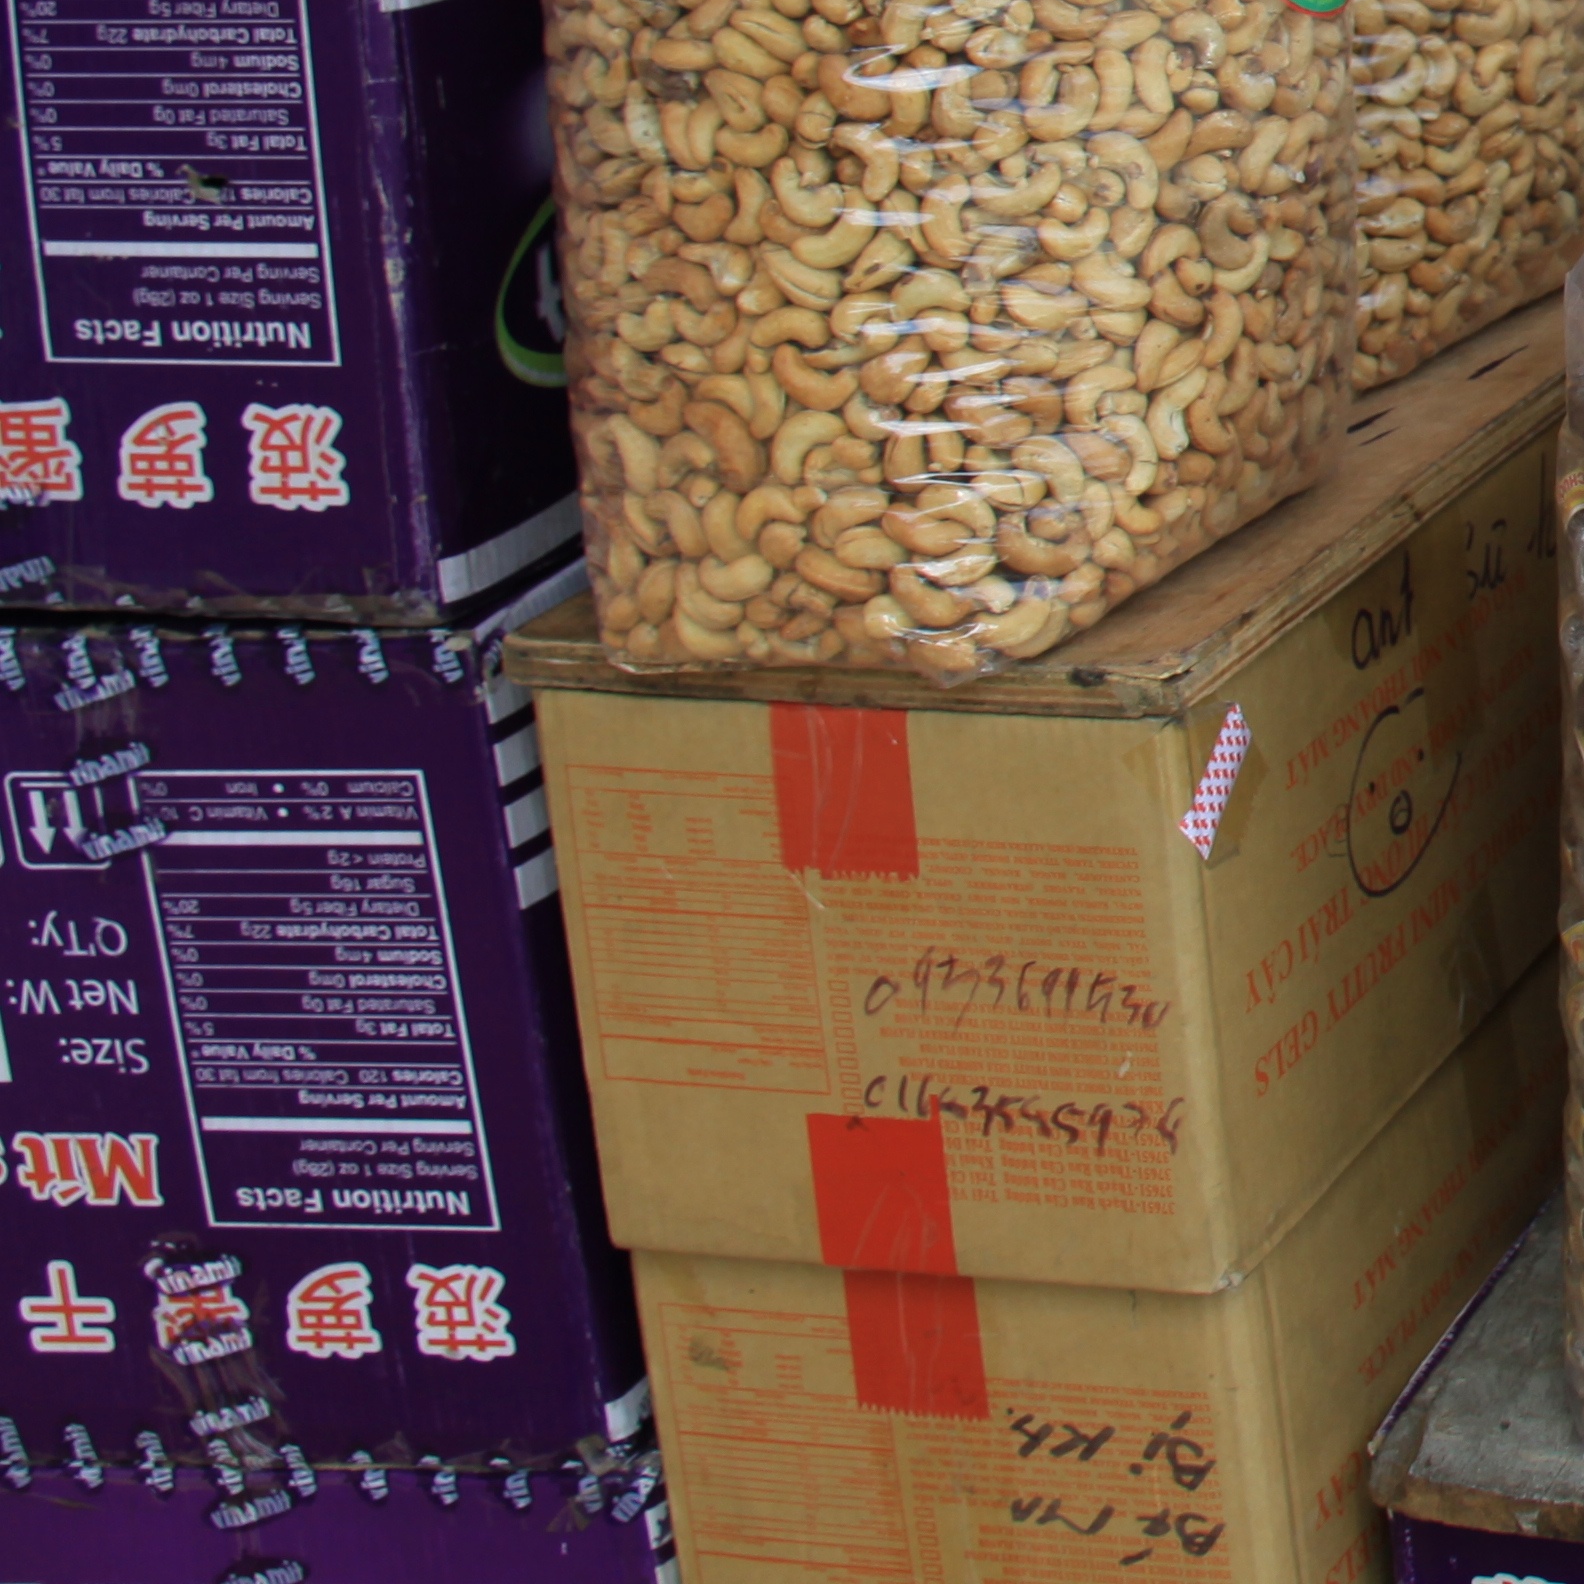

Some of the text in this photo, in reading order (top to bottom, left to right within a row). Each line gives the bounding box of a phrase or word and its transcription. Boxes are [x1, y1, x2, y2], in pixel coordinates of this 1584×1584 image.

[21, 0, 56, 16] 20%
[174, 2, 216, 18] Fiber
[221, 0, 279, 17] Dietary
[22, 25, 296, 44] Total Carbohydrate 22g 7%
[25, 51, 299, 70] Sodium 4mg 0%
[28, 78, 302, 98] Cholesterol 0mg 0%
[30, 104, 289, 125] Saturated Fat 0g 0%
[206, 132, 227, 149] 3g
[231, 135, 259, 150] Fat
[263, 135, 306, 151] Total
[99, 159, 142, 177] Daily
[242, 188, 312, 204] Calories
[143, 211, 314, 230] Amount Per Serving
[141, 264, 320, 283] Serving Per Container
[132, 288, 175, 306] (28g)
[180, 291, 200, 303] oz
[218, 292, 255, 307] Size
[258, 288, 322, 309] Serving
[74, 319, 312, 349] Nutrition Facts
[1283, 735, 1330, 791] MÁT
[28, 910, 128, 958] Q'Ty:
[1295, 887, 1353, 964] TRÁI
[1245, 938, 1295, 1013] CÂY
[1324, 924, 1407, 1031] FRUITY
[5, 979, 139, 1015] Net W:
[356, 1018, 455, 1037] Total Fat 3g
[58, 1037, 149, 1075] Size:
[1254, 1009, 1320, 1097] GELS
[298, 1089, 466, 1109] Amount Per Serving
[300, 1137, 475, 1157] Serving Per Container
[14, 1132, 164, 1207] Mít
[293, 1159, 335, 1177] (28g)
[339, 1163, 359, 1174] oz
[377, 1163, 413, 1178] Size
[417, 1160, 478, 1180] Serving
[236, 1187, 471, 1216] Nutrition Facts
